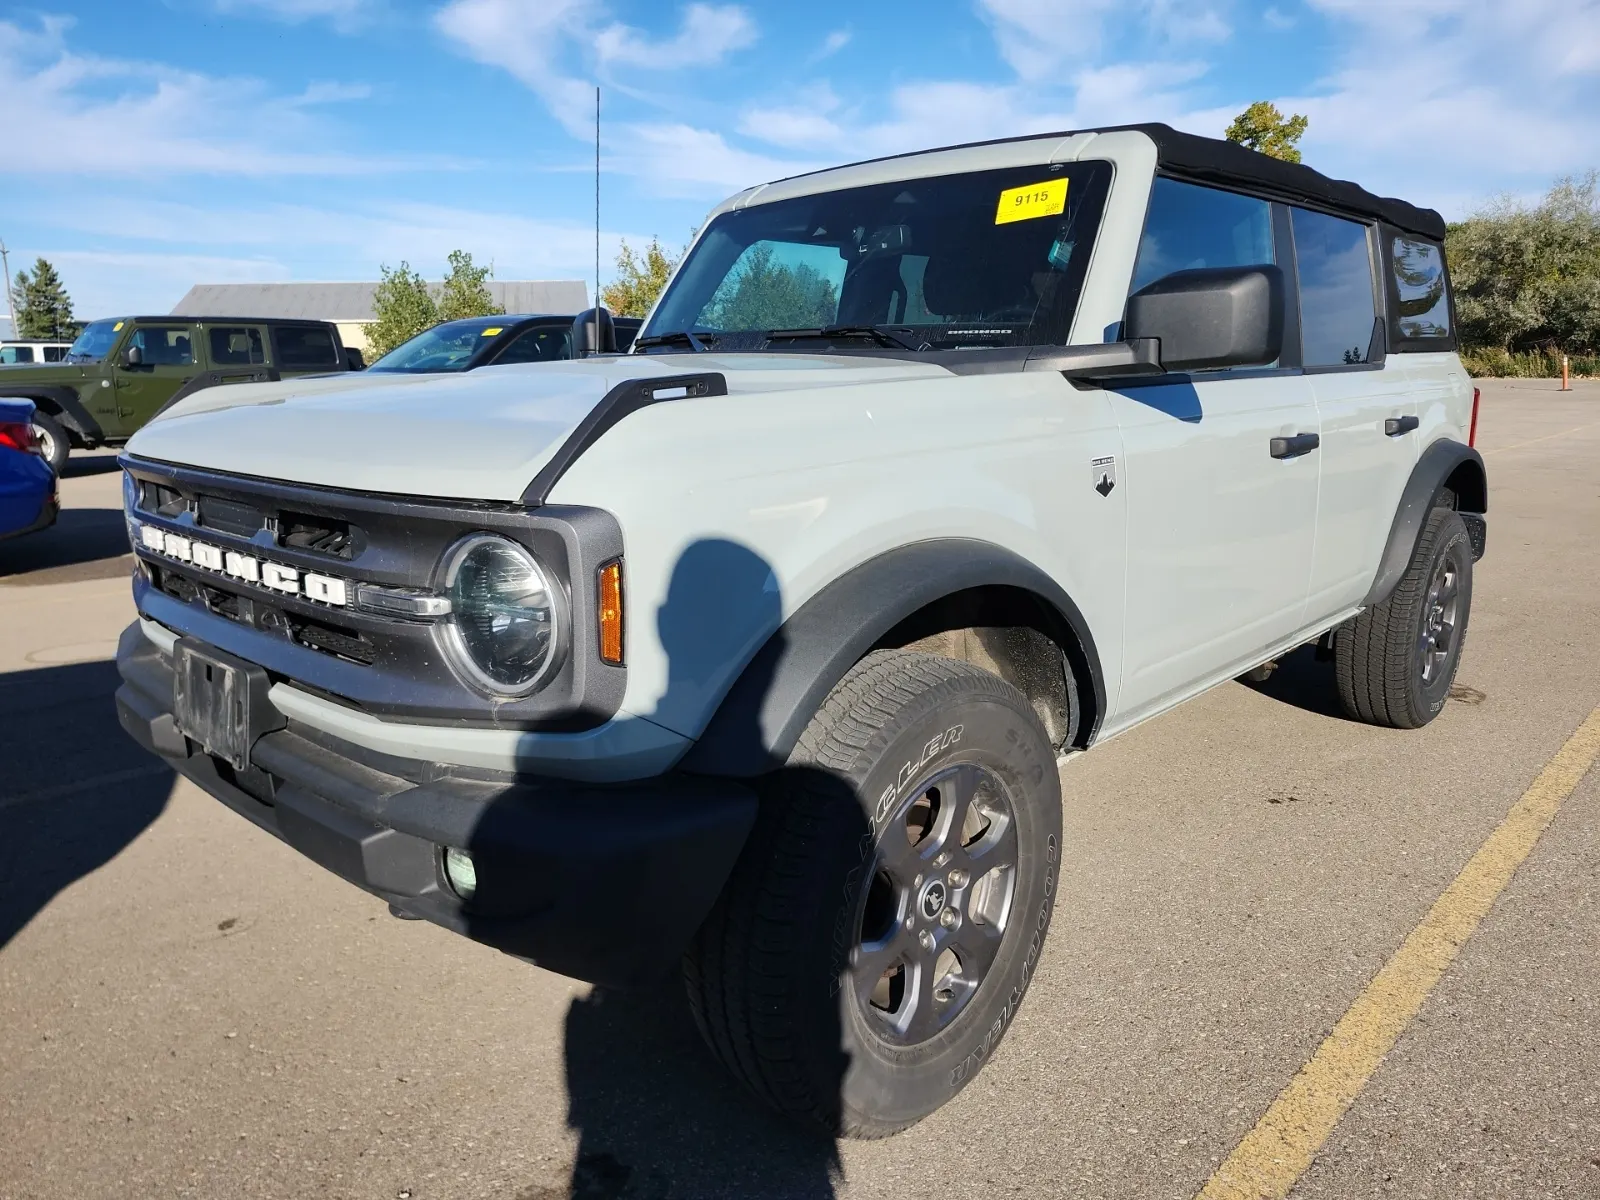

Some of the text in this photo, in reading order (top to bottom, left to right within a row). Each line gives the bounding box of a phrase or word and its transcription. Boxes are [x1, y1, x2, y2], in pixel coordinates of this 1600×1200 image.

[1014, 190, 1049, 207] 9115
[141, 525, 347, 606] BRONCO
[951, 833, 1058, 1087] GOODYEAR
